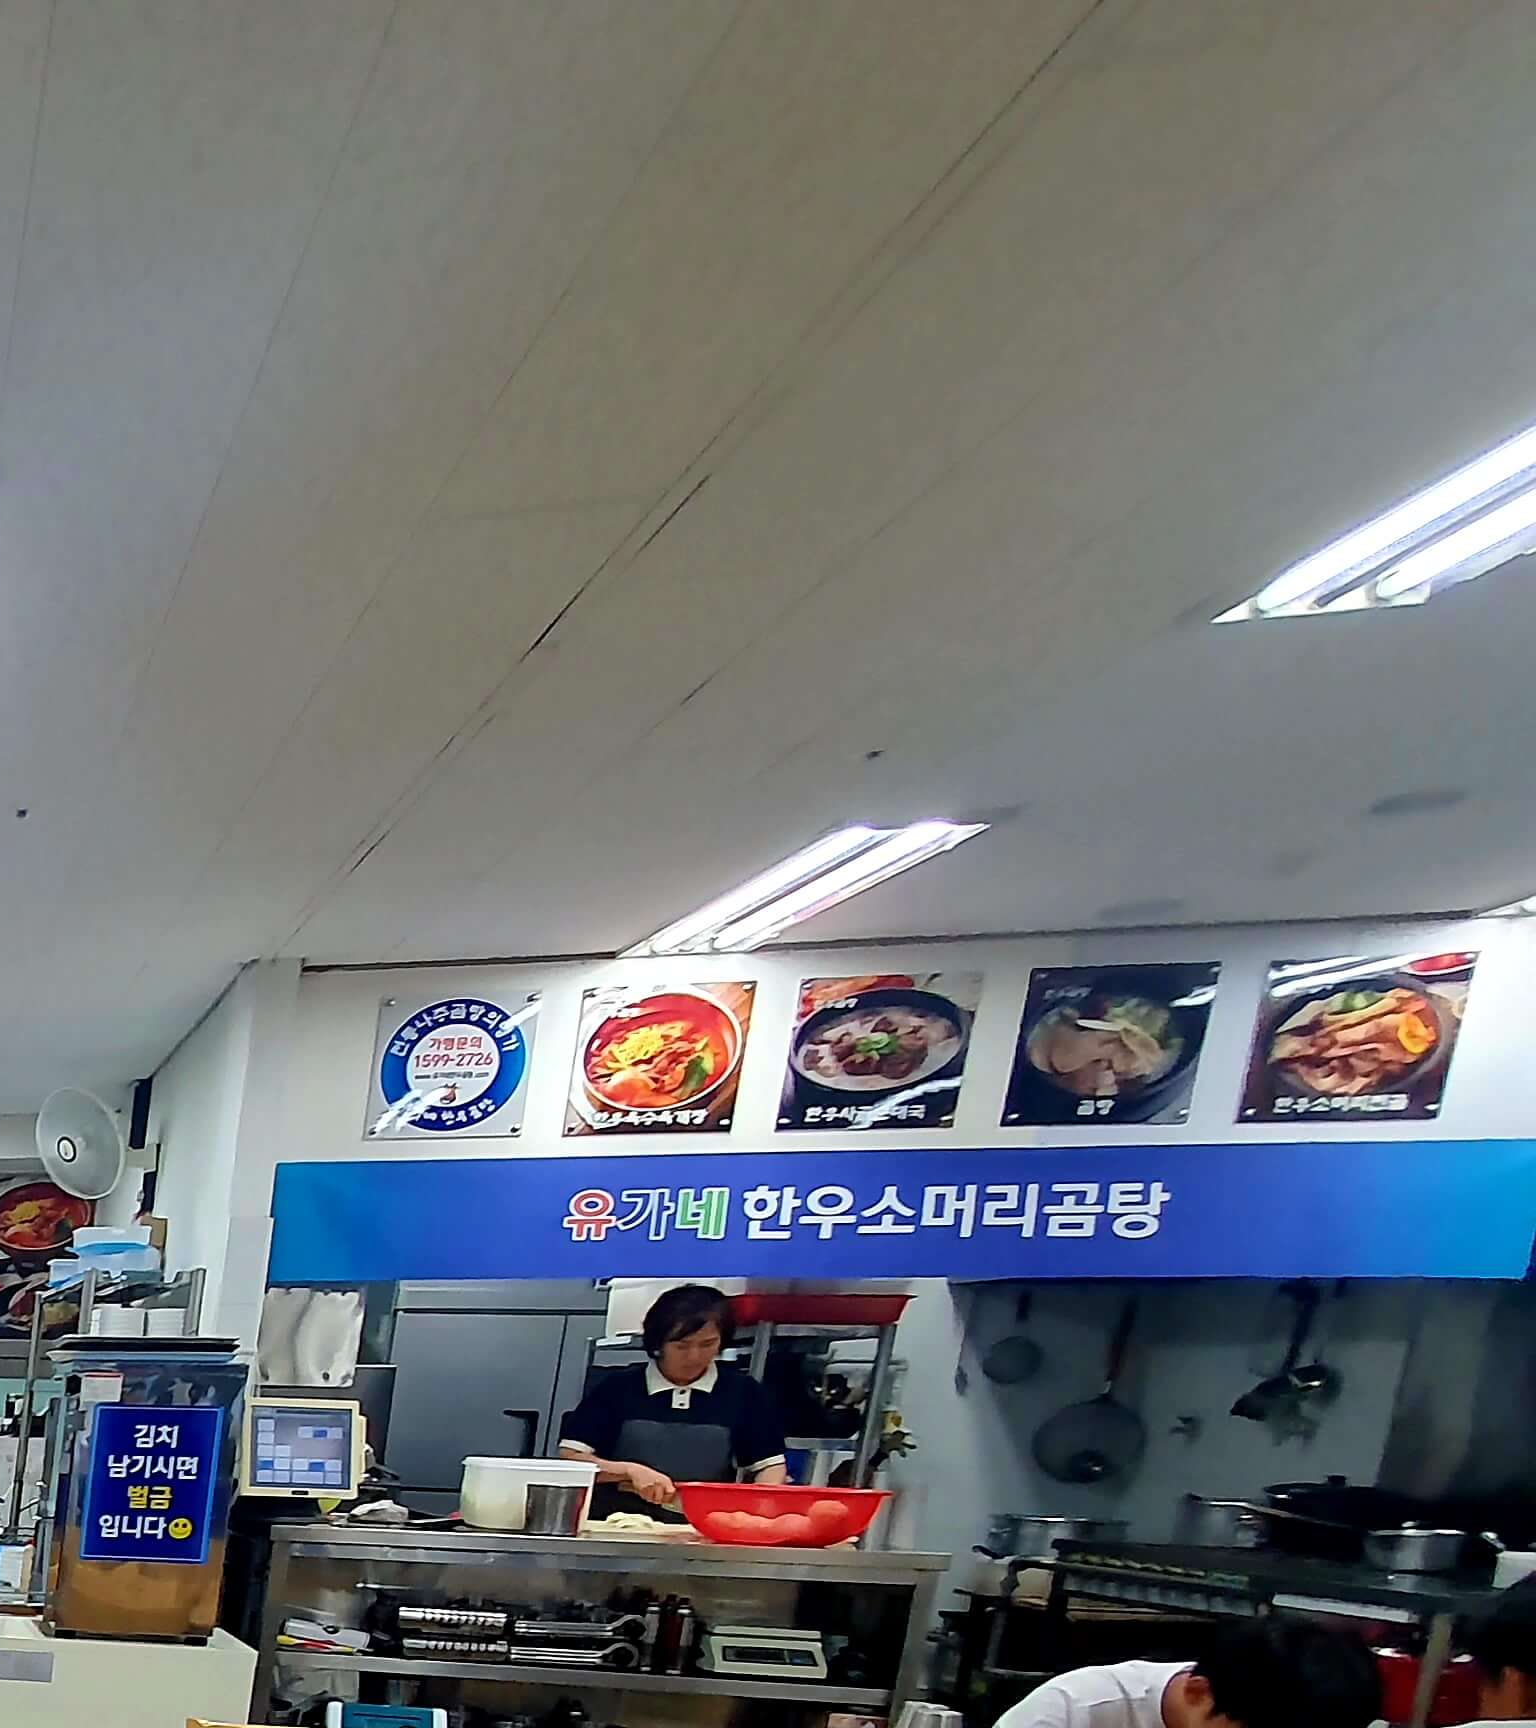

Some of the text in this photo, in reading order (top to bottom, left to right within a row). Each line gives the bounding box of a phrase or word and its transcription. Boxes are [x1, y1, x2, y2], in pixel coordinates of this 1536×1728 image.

[414, 1053, 494, 1068] 1599-2726
[563, 1180, 1171, 1242] 유가네 한우소머리곰탕
[133, 1424, 180, 1449] 김치
[107, 1456, 199, 1480] 남기시면
[127, 1485, 173, 1510] 벌금
[99, 1515, 167, 1540] 입니다
